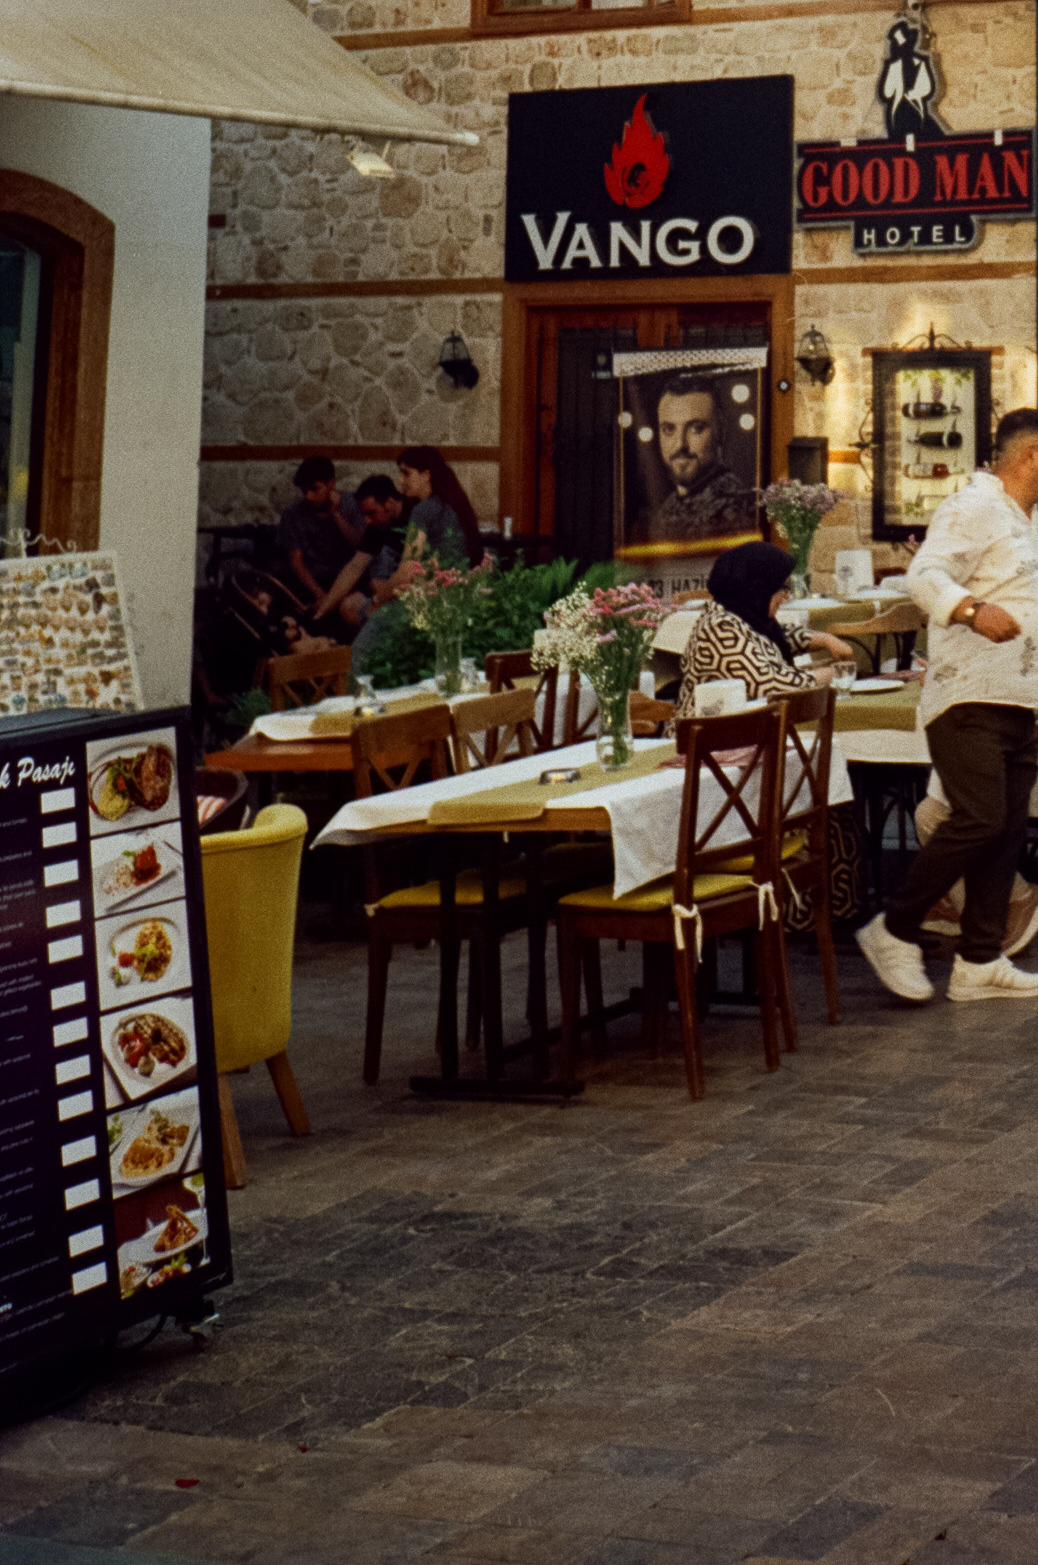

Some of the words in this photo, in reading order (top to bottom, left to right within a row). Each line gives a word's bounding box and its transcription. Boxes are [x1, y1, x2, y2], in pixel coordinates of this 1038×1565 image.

[801, 155, 921, 208] GOOD
[933, 149, 1030, 202] MAN
[520, 210, 756, 271] VANGO
[862, 224, 966, 245] HOTEL
